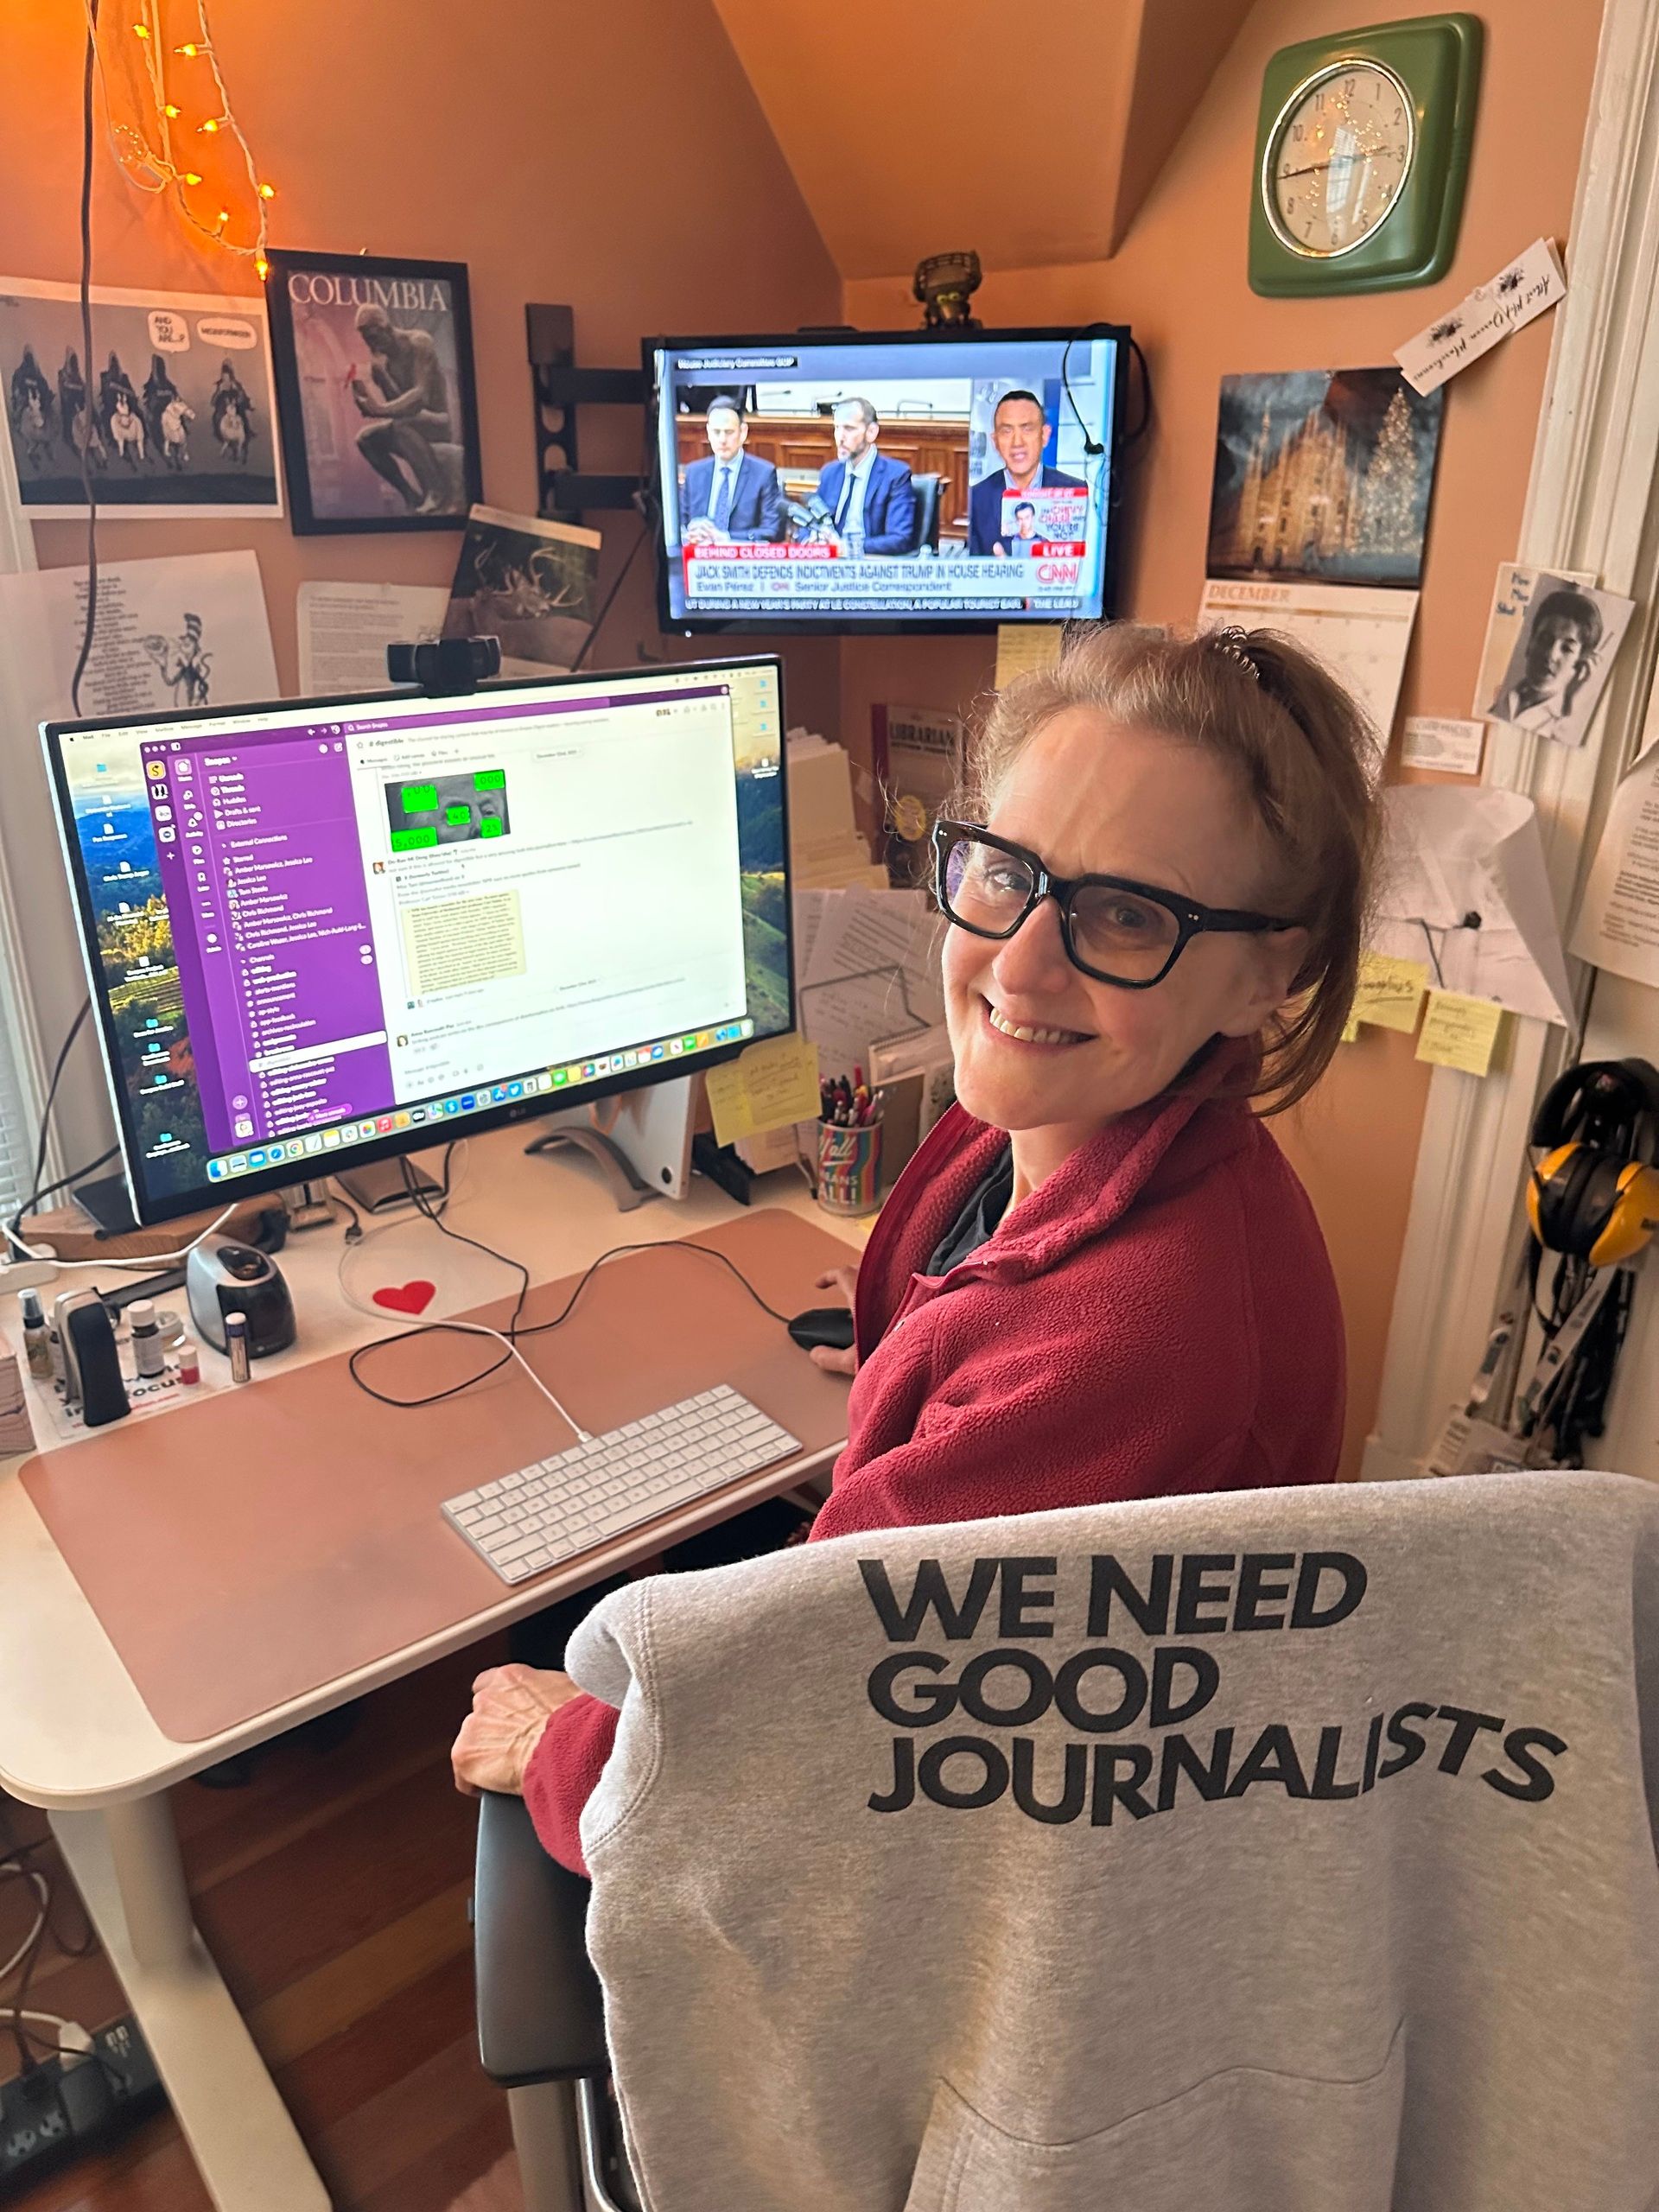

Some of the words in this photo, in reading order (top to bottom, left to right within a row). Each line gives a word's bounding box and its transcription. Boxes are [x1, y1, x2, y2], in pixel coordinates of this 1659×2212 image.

[1344, 79, 1355, 97] 12
[1376, 82, 1381, 101] 1
[1315, 94, 1325, 111] 11
[1394, 107, 1402, 126] 2
[1293, 124, 1304, 142] 10
[1397, 145, 1405, 162] 3
[1287, 197, 1294, 214] 8
[1305, 221, 1312, 238] 7
[1360, 216, 1369, 232] 5
[1331, 231, 1338, 245] 6
[288, 273, 448, 312] COLUMBIA
[694, 546, 738, 559] BEHIND
[739, 546, 785, 559] CLOSED
[788, 546, 830, 558] DOORS
[1043, 544, 1075, 557] LIVE
[695, 564, 719, 580] JACK
[721, 564, 750, 580] SMITH
[752, 564, 794, 580] DEFENDS
[797, 564, 856, 580] INDICTMENTS
[859, 564, 899, 579] AGAINST
[901, 564, 933, 579] TRUMP
[937, 564, 945, 578] IN
[949, 564, 980, 578] HOUSE
[982, 563, 1024, 578] HEARING
[1037, 563, 1077, 584] CNN
[697, 582, 723, 592] Evan
[795, 582, 828, 592] Senior
[830, 582, 869, 592] Justice
[871, 581, 951, 594] Correspondent
[1209, 583, 1291, 602] DECEMBER
[859, 1556, 1058, 1643] WE
[1088, 1552, 1369, 1637] NEED
[868, 1647, 1220, 1732] GOOD
[868, 1701, 1568, 1827] JOURNALISTS
